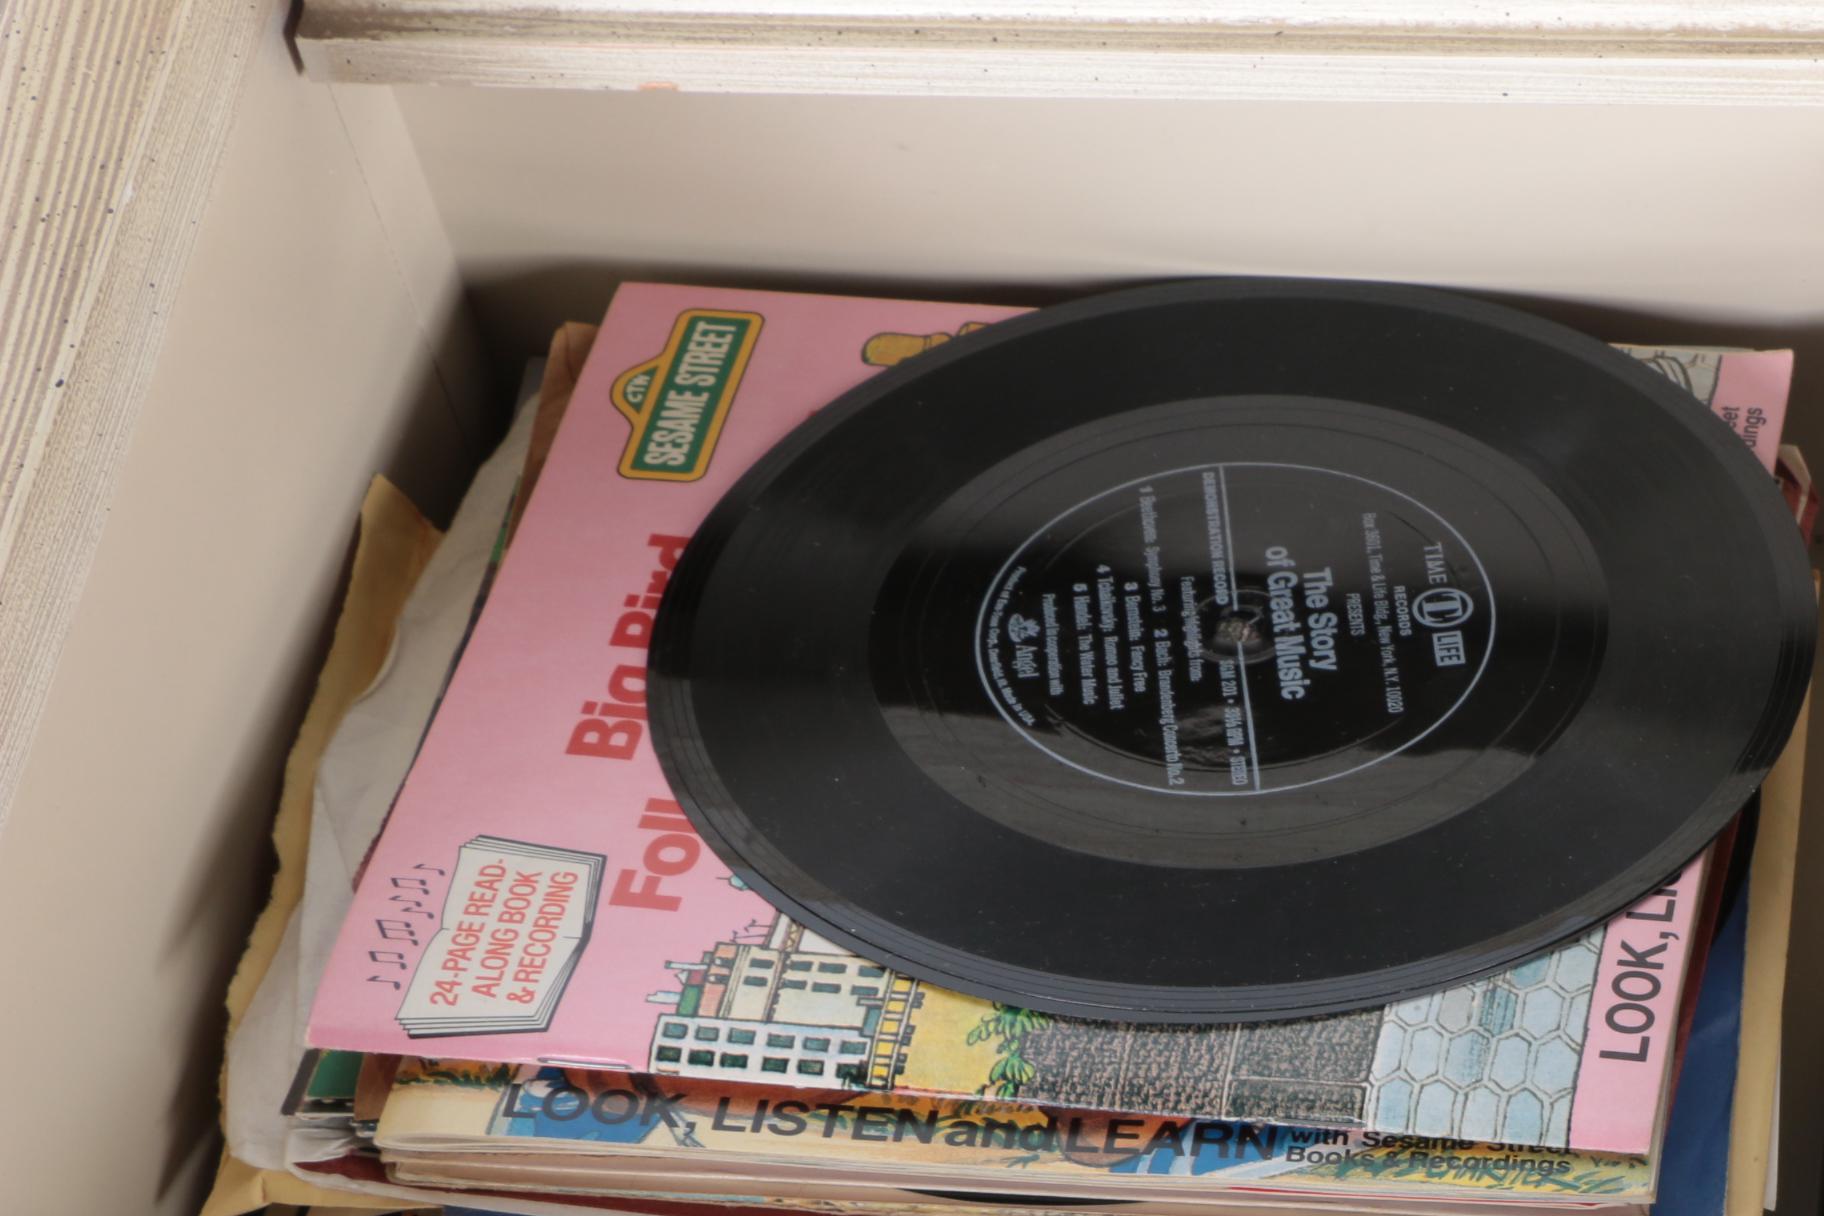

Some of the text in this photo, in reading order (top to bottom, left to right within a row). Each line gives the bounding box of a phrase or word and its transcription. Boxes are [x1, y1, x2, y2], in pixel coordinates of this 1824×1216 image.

[643, 320, 737, 466] SESAME STREET
[1201, 470, 1223, 559] DEMONSTRATION
[1095, 564, 1111, 574] 4
[1142, 545, 1163, 588] Symphony
[1211, 558, 1229, 607] RECORD
[1072, 582, 1087, 593] 5
[1149, 588, 1165, 603] No.
[1371, 582, 1387, 599] Life
[1423, 542, 1466, 667] TIME LIFE
[1264, 546, 1312, 701] of Great Music
[1302, 566, 1339, 672] The Story
[1345, 592, 1365, 638] PRESENTS
[1393, 585, 1413, 638] RECORDS
[565, 533, 694, 761] Big Bird
[1077, 634, 1093, 651] The
[1123, 582, 1148, 693] 3 Bernstein: Fancy Free
[1153, 627, 1168, 638] 2
[1377, 624, 1394, 644] New
[1015, 644, 1040, 680] Angel
[1078, 651, 1095, 678] Water
[1102, 635, 1120, 665] Romeo
[1155, 639, 1171, 667] Bach:
[1080, 678, 1097, 705] Music
[1106, 666, 1122, 684] and
[1221, 679, 1238, 697] 201
[1107, 684, 1124, 710] Juliet
[1384, 685, 1403, 713] 10020
[1163, 723, 1181, 763] Concerto
[1227, 727, 1243, 746] RPM
[1230, 756, 1247, 786] STEREO
[608, 797, 701, 912] Foll
[429, 858, 509, 1006] 24-PAGE READ-
[471, 870, 544, 999] ALONG BOOK
[505, 870, 580, 1005] & RECORDING
[1598, 930, 1681, 1063] LOOK,
[501, 1082, 1280, 1164] LOOK, LISTEN and LEARN
[1289, 1126, 1350, 1147] with
[1361, 1131, 1475, 1153] Sesame
[1285, 1145, 1376, 1168] Books
[1382, 1150, 1400, 1168] &
[1404, 1150, 1571, 1177] Recordings
